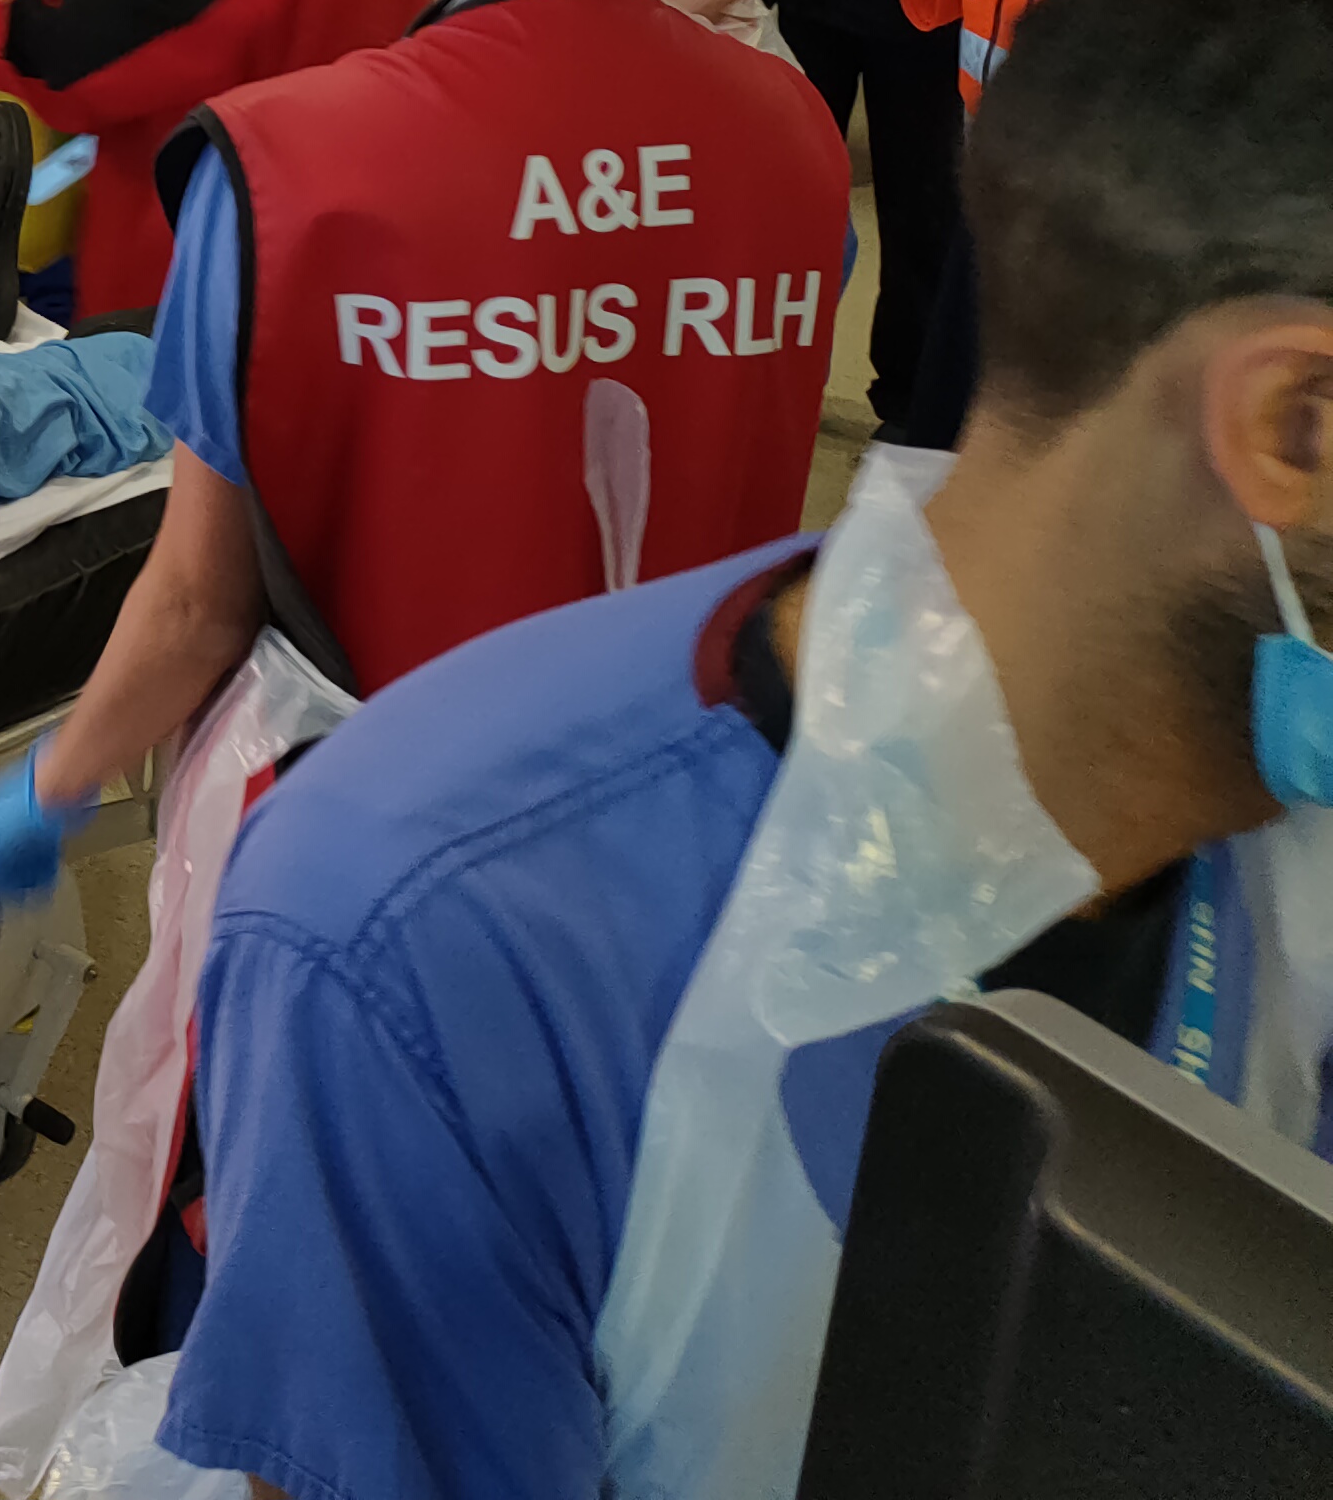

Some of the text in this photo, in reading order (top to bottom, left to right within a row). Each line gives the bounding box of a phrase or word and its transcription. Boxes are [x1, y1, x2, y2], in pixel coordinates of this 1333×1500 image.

[509, 143, 695, 240] A&E
[334, 270, 822, 381] RESUS RLH
